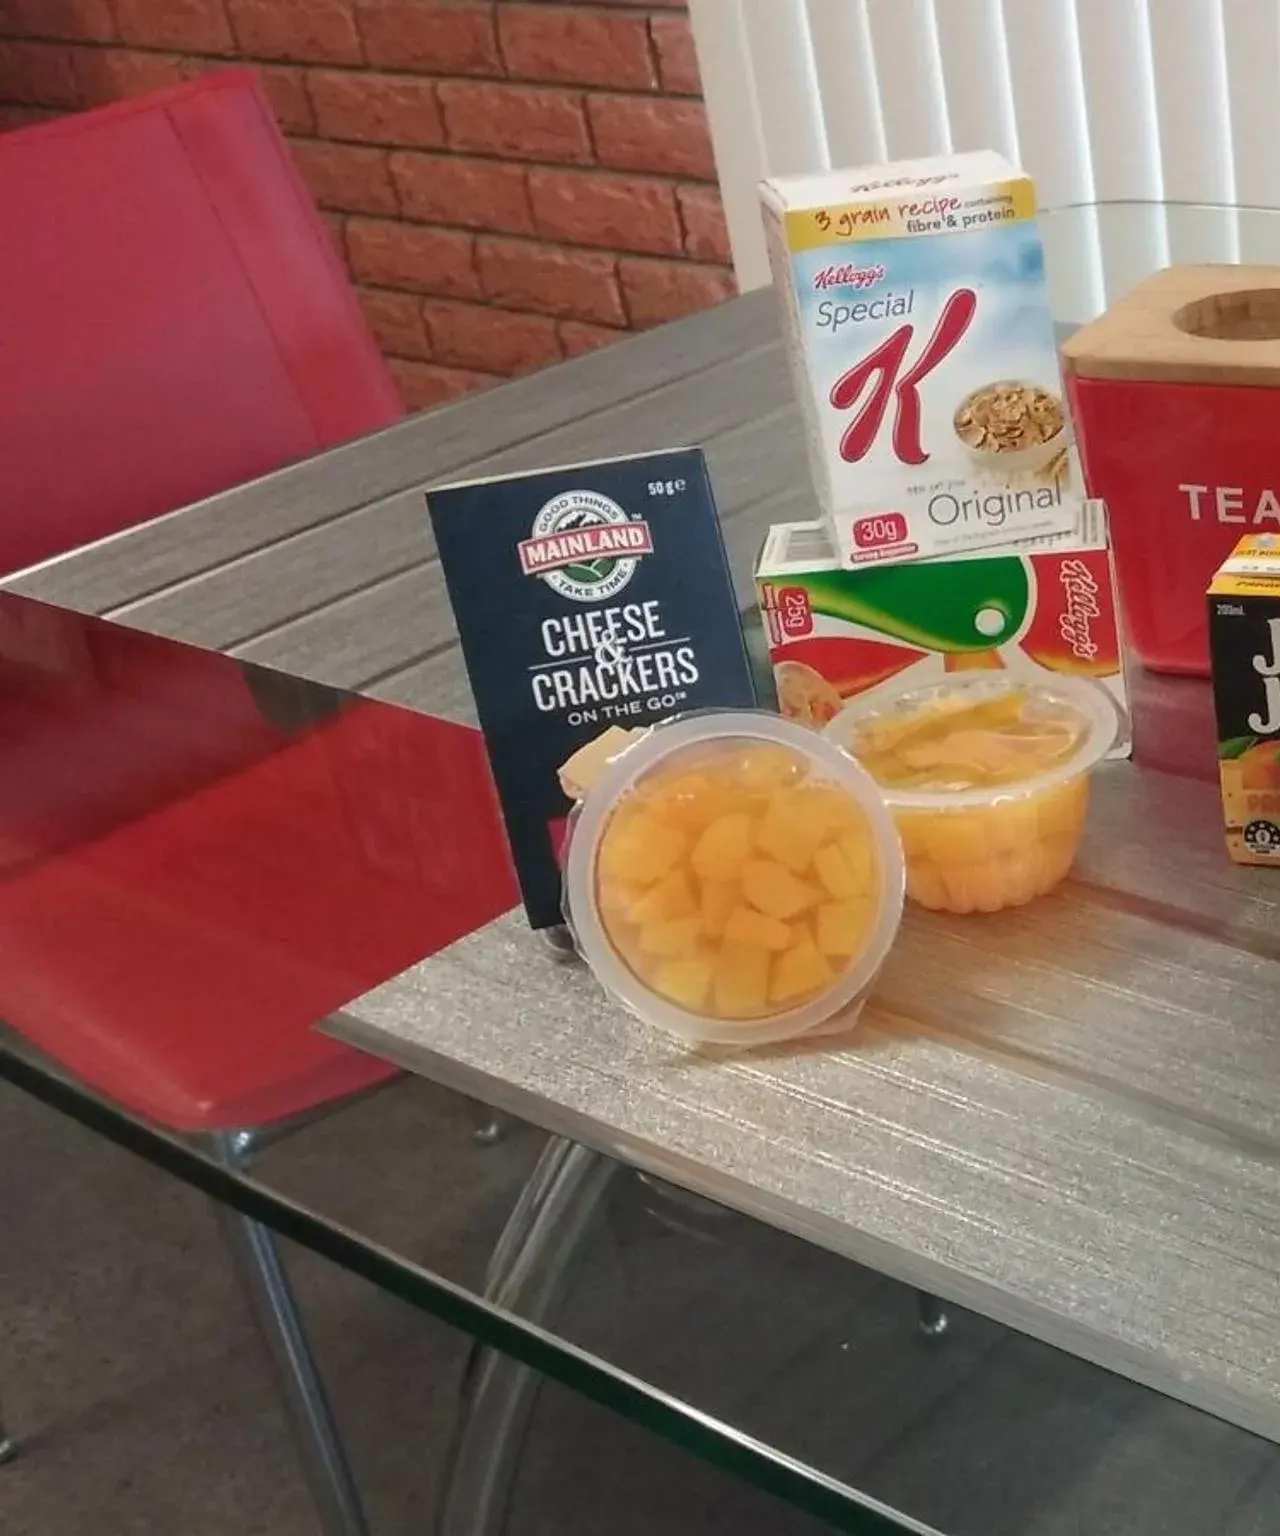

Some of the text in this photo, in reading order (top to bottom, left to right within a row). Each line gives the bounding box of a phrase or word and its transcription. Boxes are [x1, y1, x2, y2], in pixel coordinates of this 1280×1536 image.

[812, 209, 831, 232] 3
[838, 207, 890, 237] grain
[898, 194, 962, 221] recipe
[906, 208, 1015, 233] fibre & protein
[813, 263, 886, 290] Kellogg's
[815, 290, 915, 333] Special
[829, 287, 977, 465] K
[539, 495, 620, 533] GOOD THINGS
[927, 474, 1062, 527] Original
[525, 527, 645, 566] MAINLAND
[860, 519, 898, 542] 30g
[558, 569, 628, 597] TAKE TIME
[541, 600, 665, 658] CHEESE
[1059, 558, 1102, 662] Kellogg's
[593, 627, 632, 669] &
[531, 647, 699, 712] CRACKERS
[567, 709, 599, 727] ON
[601, 701, 642, 720] THE
